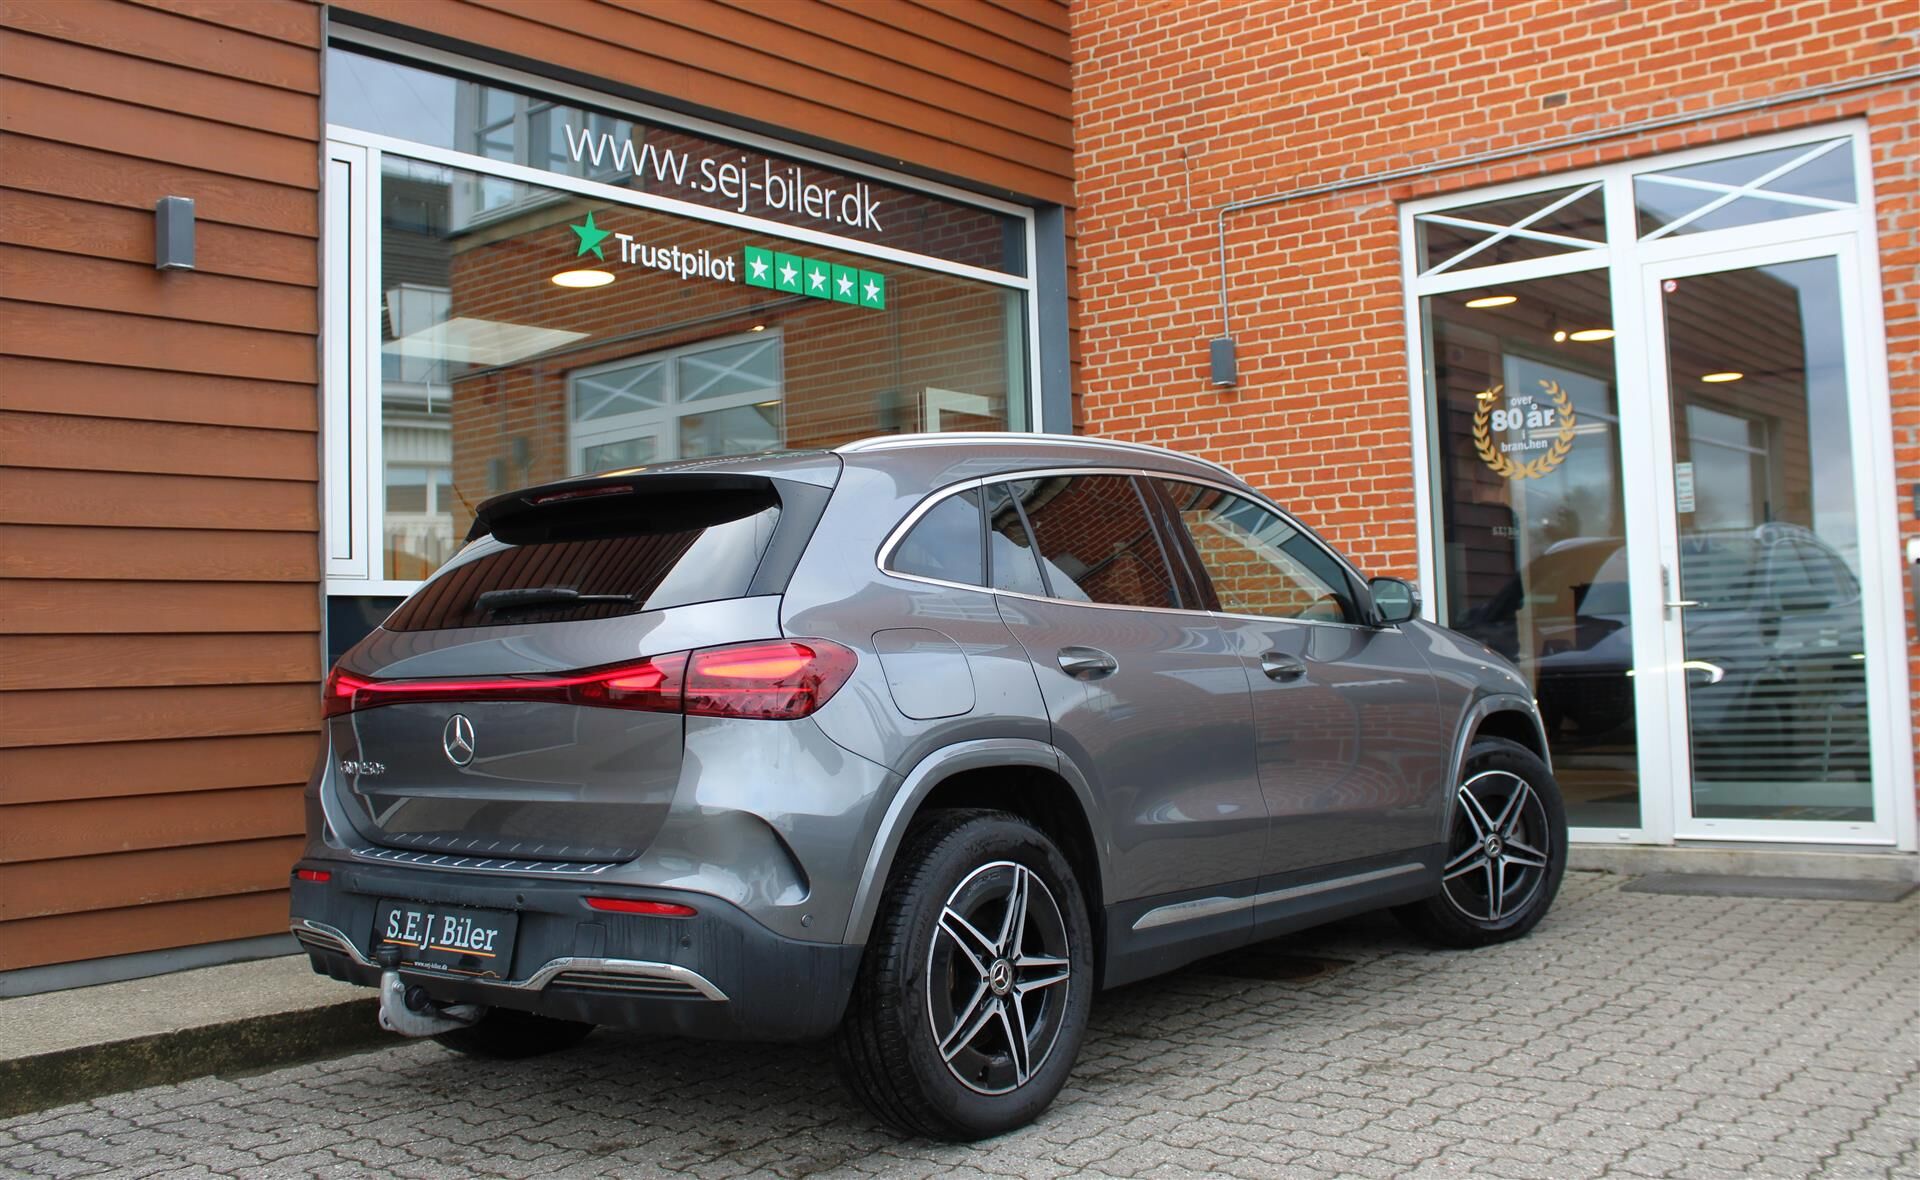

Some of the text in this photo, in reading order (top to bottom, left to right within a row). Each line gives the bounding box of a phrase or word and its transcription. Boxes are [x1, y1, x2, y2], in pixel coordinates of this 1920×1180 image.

[565, 123, 883, 232] www.sej-biler.dk
[614, 232, 736, 283] Trustpilot
[1491, 403, 1555, 431] 80 år
[1511, 395, 1533, 407] over
[1501, 439, 1548, 452] branchen
[386, 909, 498, 951] S.E.J. Biler
